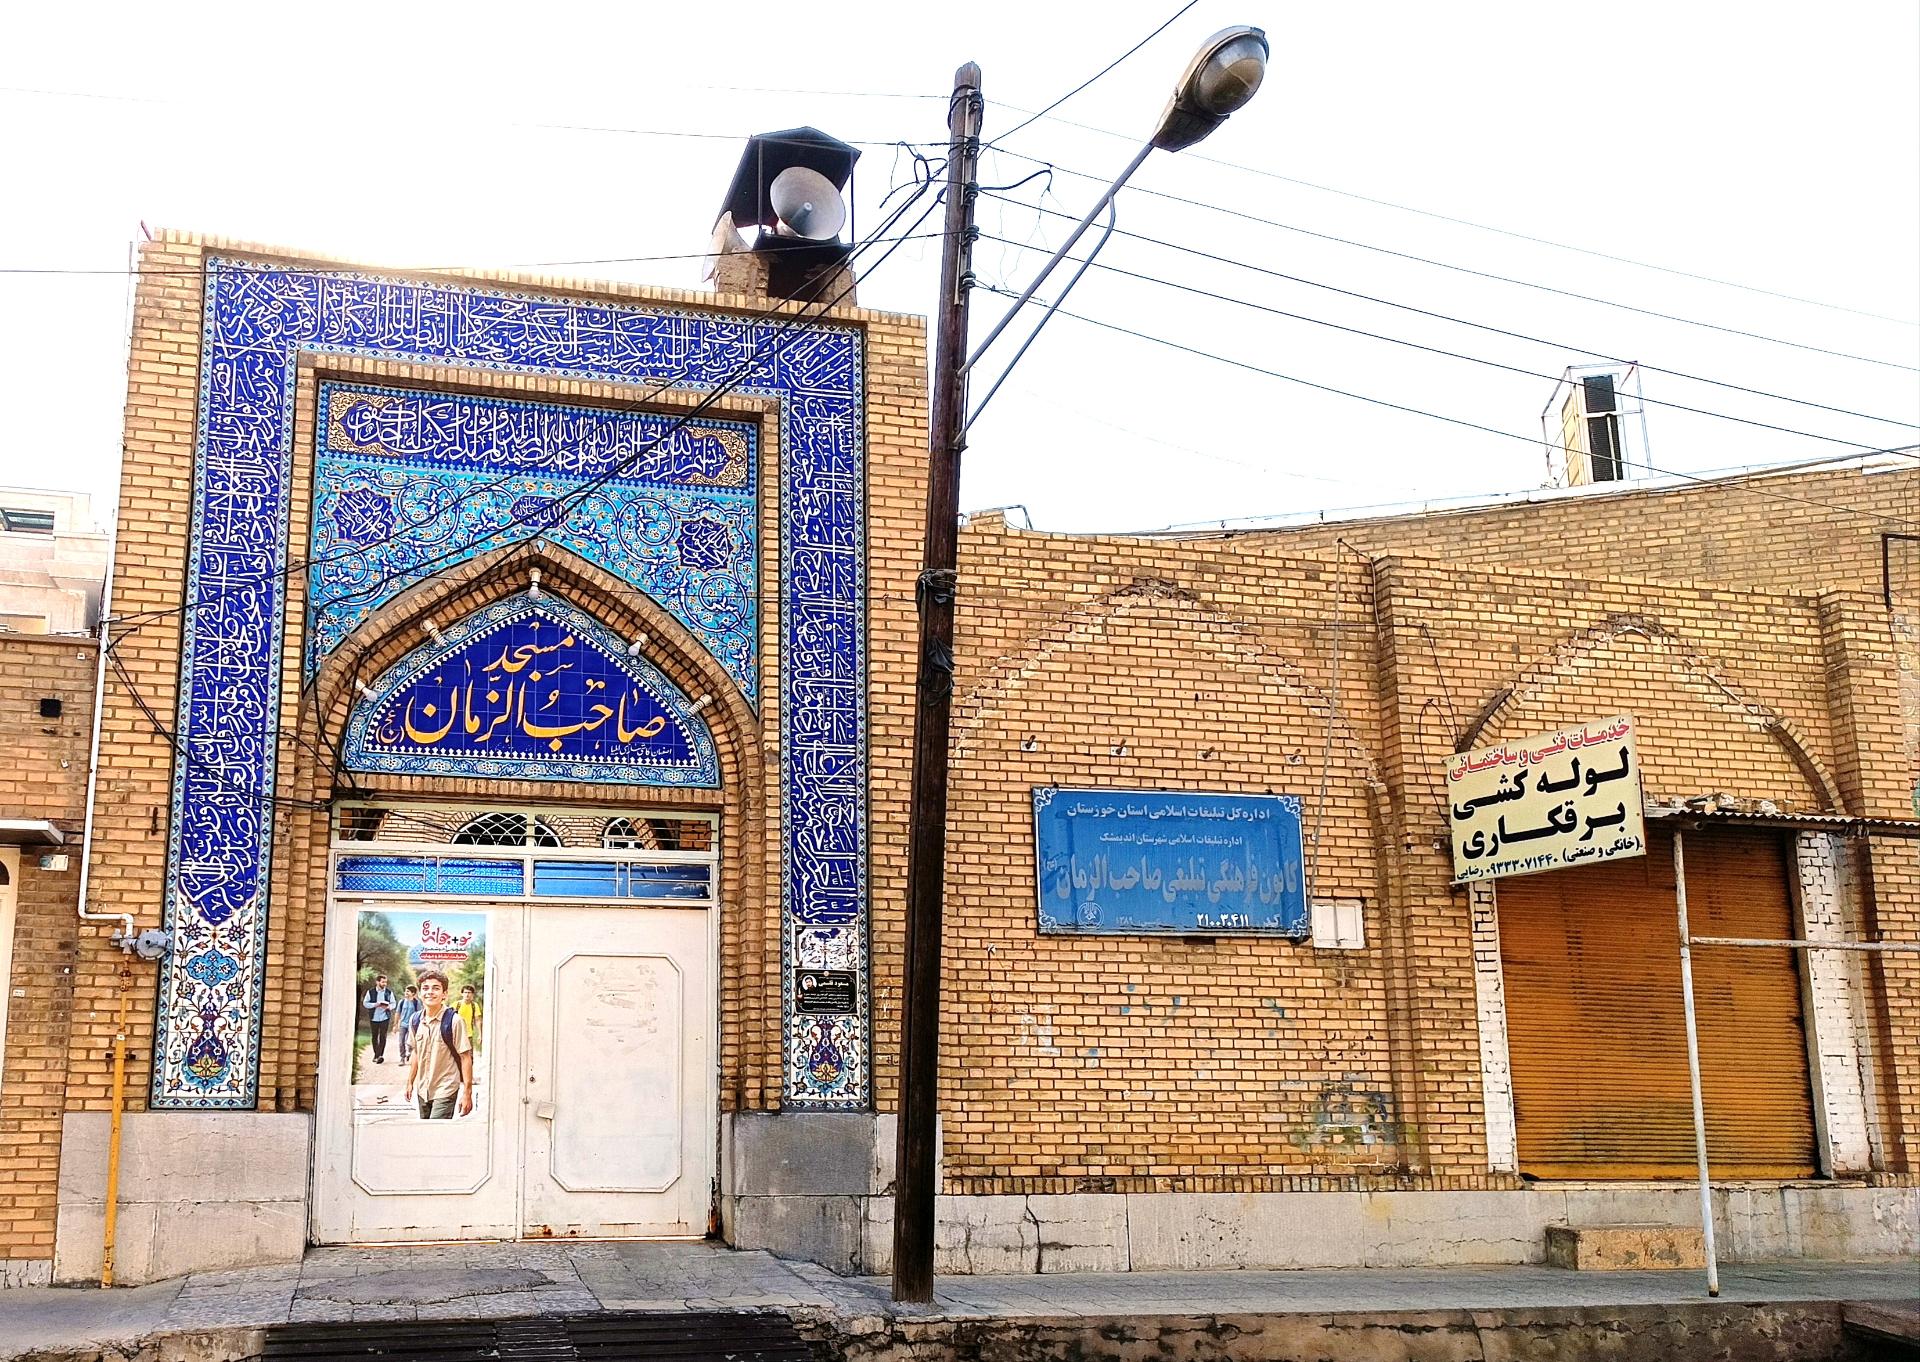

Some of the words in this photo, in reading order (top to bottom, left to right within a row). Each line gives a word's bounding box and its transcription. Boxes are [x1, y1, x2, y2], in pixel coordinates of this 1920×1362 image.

[482, 634, 574, 682] مسجد
[1568, 718, 1630, 750] خدمات
[1531, 733, 1567, 765] فنی
[1450, 750, 1518, 781] ساختمانی
[1518, 750, 1530, 768] و
[1536, 746, 1630, 797] لوله
[1453, 769, 1528, 820] کشی
[1067, 802, 1116, 818] خوزستان
[1117, 804, 1147, 818] استان
[1149, 805, 1186, 819] اسلامی
[1187, 806, 1225, 821] تبلیغات
[1226, 807, 1242, 820] کل
[1242, 808, 1270, 821] اداره
[1099, 832, 1135, 844] اندیمشک
[1136, 832, 1168, 846] شهرستان
[1168, 834, 1195, 846] اسلامی
[1196, 834, 1223, 846] تبلیغات
[1223, 836, 1243, 847] اداره
[1605, 836, 1641, 857] (خانگی
[1562, 847, 1595, 863] صنعتی)
[1456, 865, 1484, 880] رضایی
[1486, 854, 1558, 875] ۰۹۳۳۳۰۷۱۴۴۰
[1057, 853, 1108, 901] الزمان
[1109, 854, 1162, 898] صاحب
[1162, 855, 1206, 902] تبلیغی
[1207, 853, 1258, 903] فرهنگی
[1260, 859, 1298, 904] کانون
